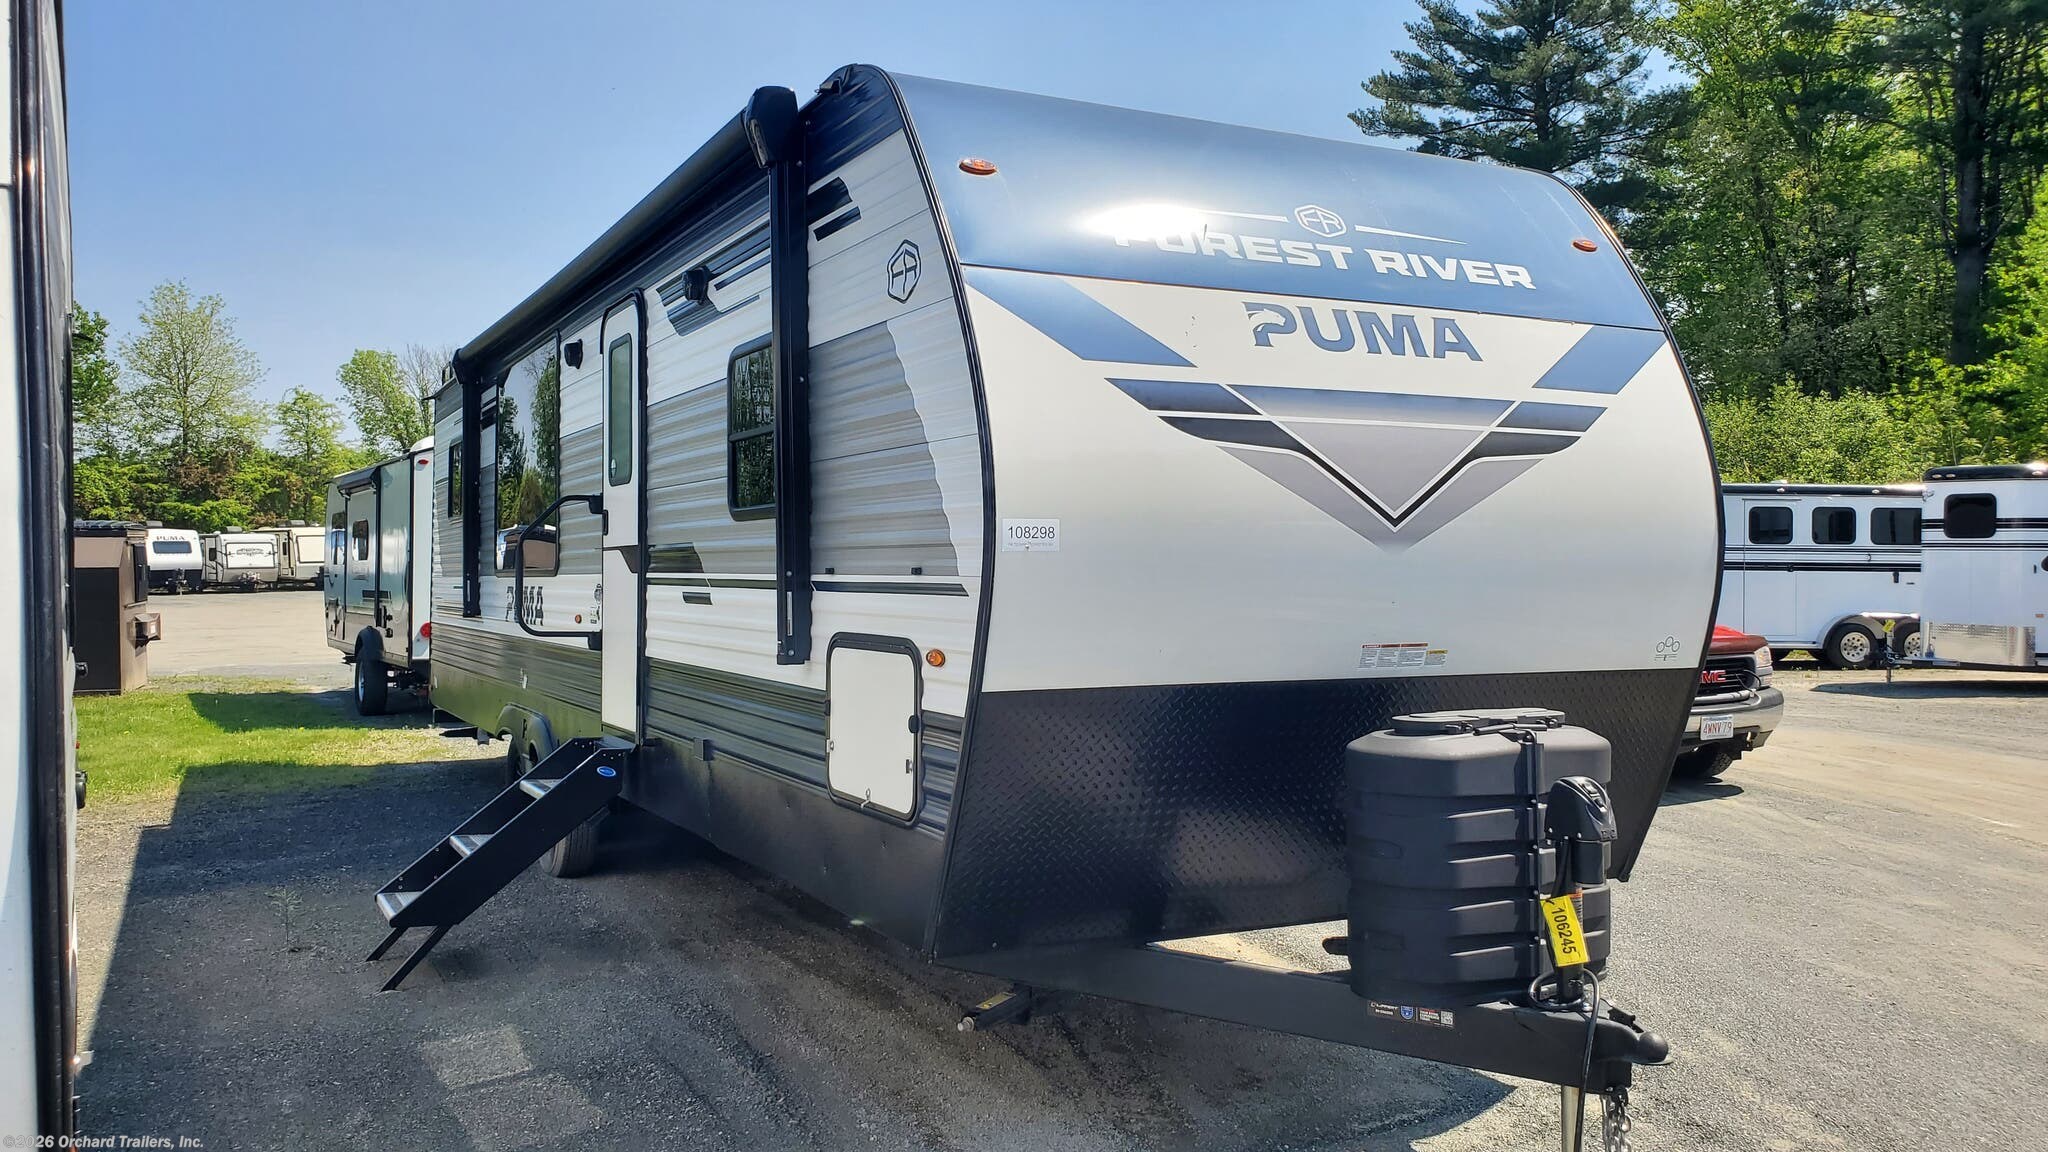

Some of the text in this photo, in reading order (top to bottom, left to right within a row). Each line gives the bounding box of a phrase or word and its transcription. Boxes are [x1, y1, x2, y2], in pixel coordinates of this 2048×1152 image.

[1364, 248, 1537, 290] RIVER
[1241, 301, 1483, 362] PUMA
[1007, 525, 1055, 539] 108298
[505, 585, 544, 626] PMA
[1701, 670, 1726, 683] MC
[1551, 907, 1577, 954] 106245
